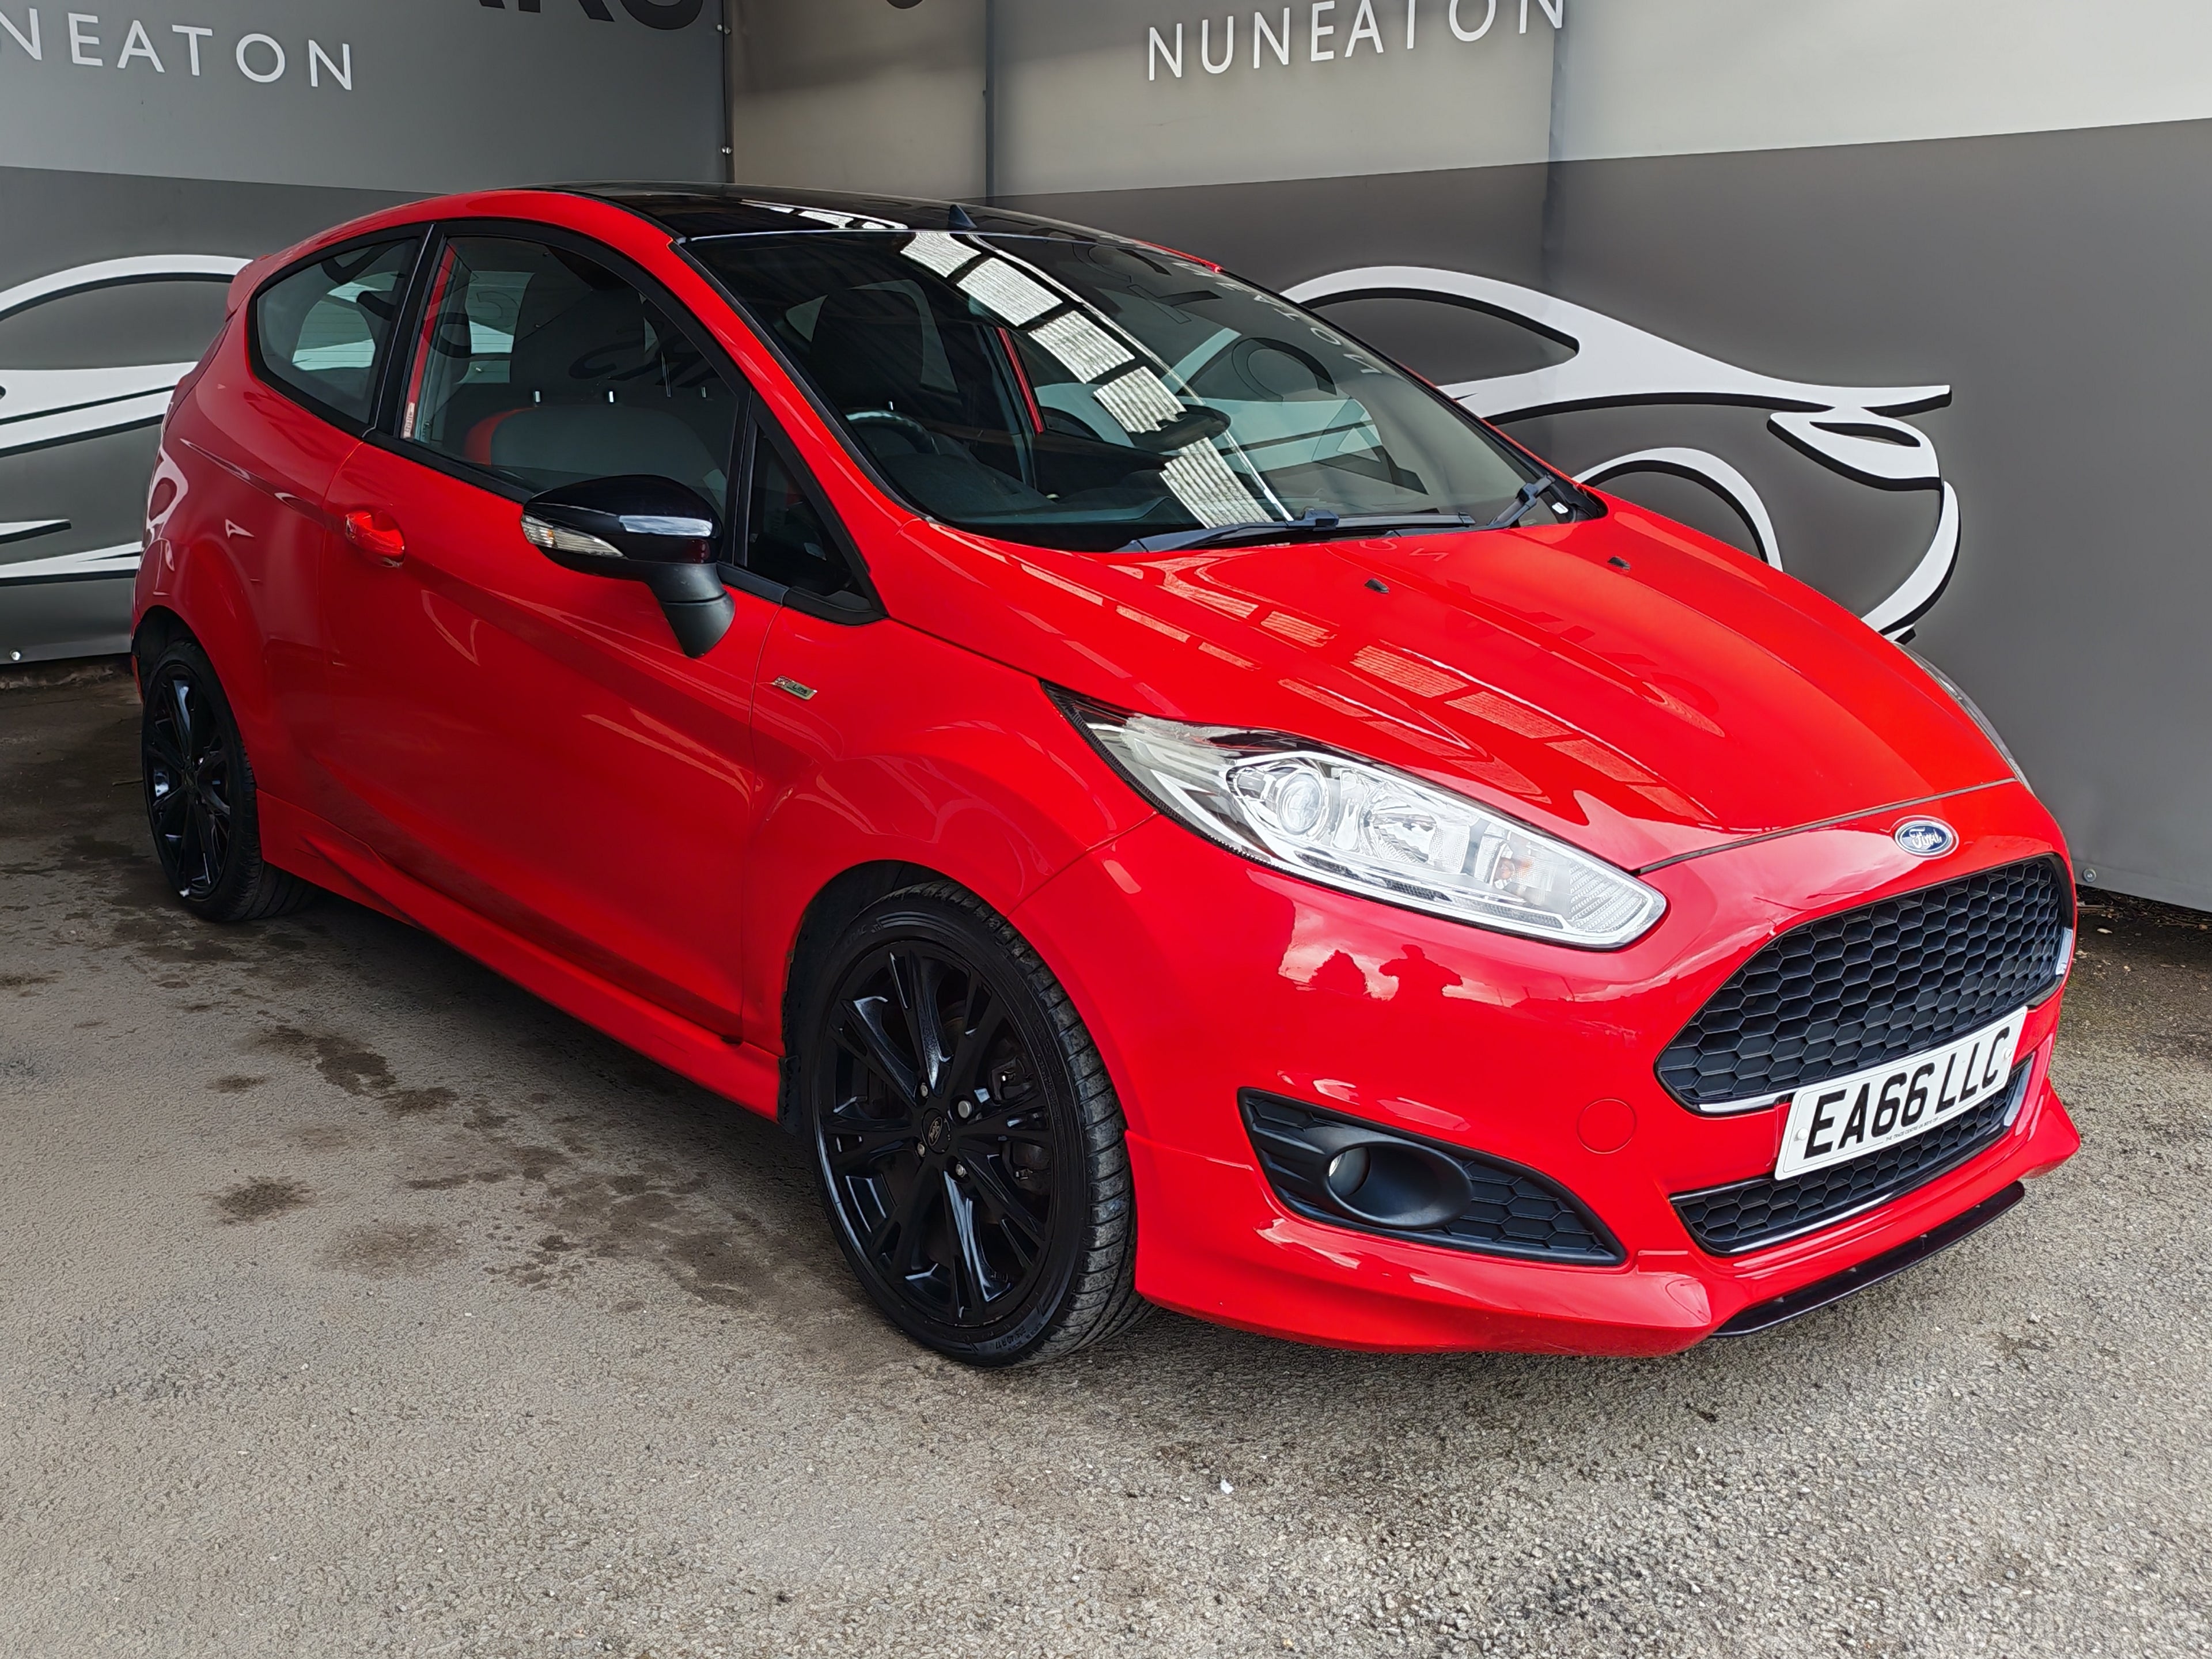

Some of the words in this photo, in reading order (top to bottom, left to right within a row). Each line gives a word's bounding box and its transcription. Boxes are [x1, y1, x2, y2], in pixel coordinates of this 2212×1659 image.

[1908, 827, 1942, 849] Ford
[1804, 1062, 1936, 1160] EA66
[1935, 1027, 2010, 1114] LLC
